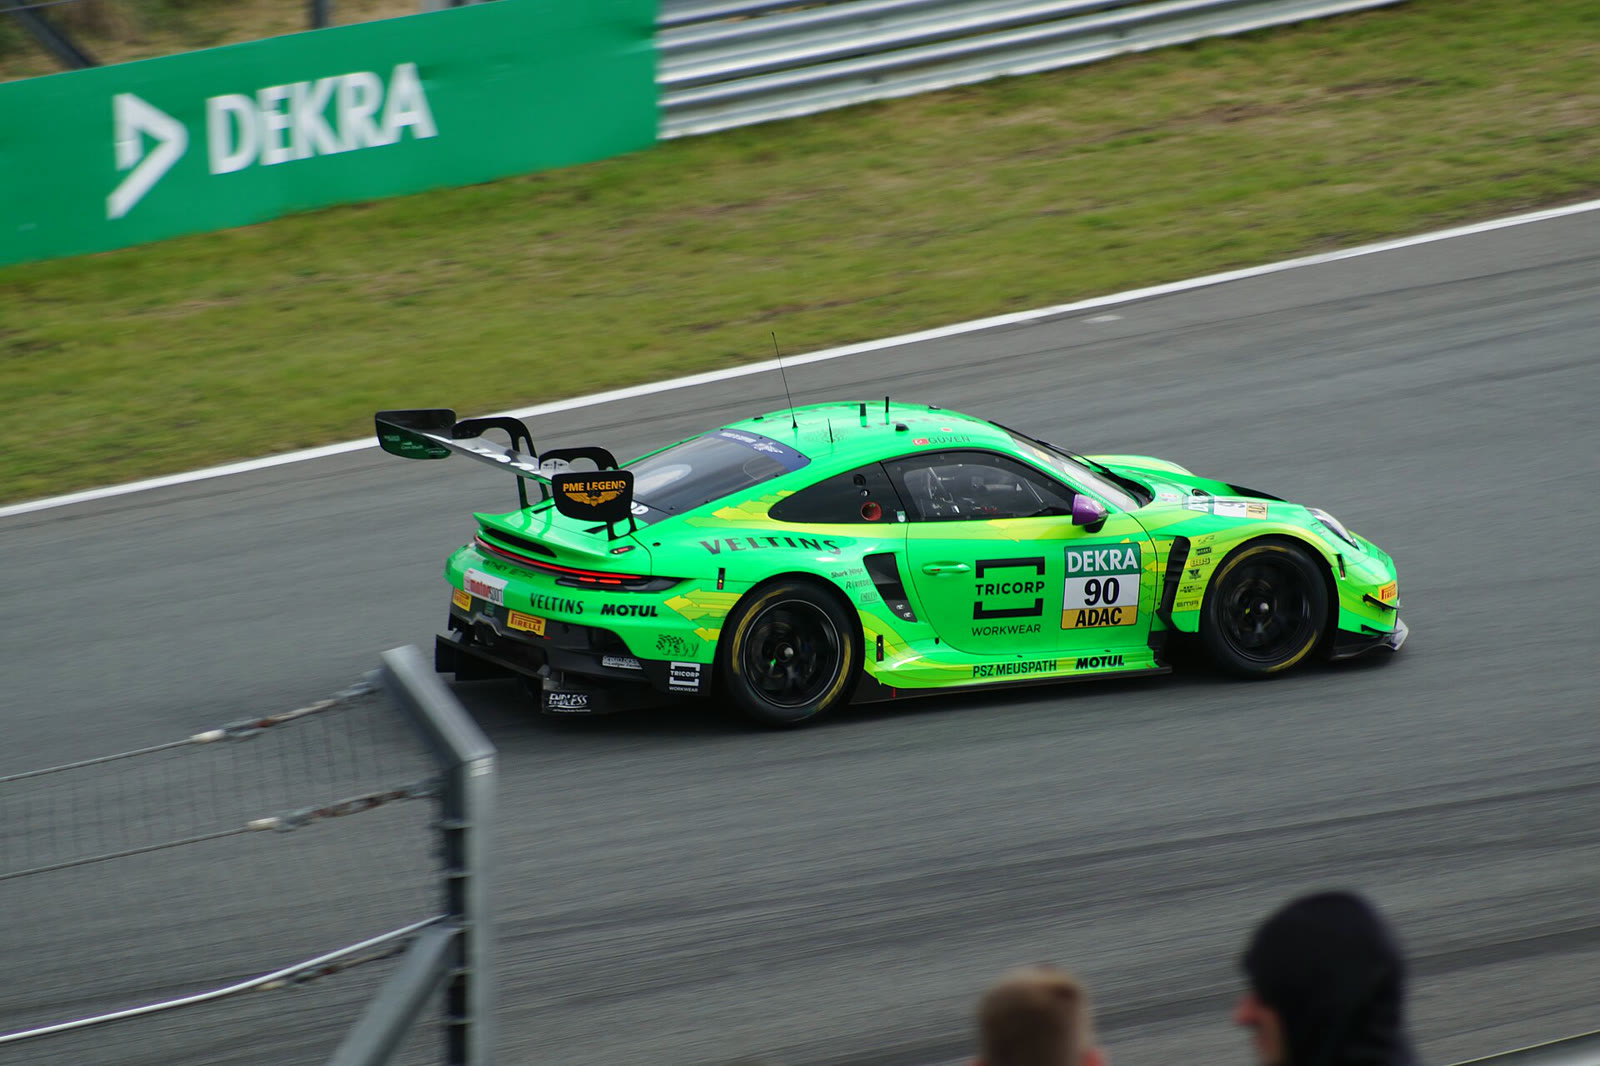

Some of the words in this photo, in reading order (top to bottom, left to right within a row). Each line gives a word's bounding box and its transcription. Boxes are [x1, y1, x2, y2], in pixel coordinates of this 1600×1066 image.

[206, 62, 438, 175] DEKRA
[562, 483, 585, 492] PME
[586, 480, 626, 491] LEGEND
[699, 536, 842, 556] VELTINS
[1067, 548, 1138, 573] DEKRA
[975, 581, 1045, 596] TRICORP
[1083, 577, 1120, 606] 90
[530, 593, 583, 615] VELTINS
[600, 603, 658, 618] MOTUL
[510, 612, 543, 632] PIRELLI
[1075, 607, 1122, 628] ADAC
[971, 624, 1041, 636] WORKWEAR
[972, 665, 994, 678] PSZ
[995, 660, 1057, 676] MEUSPATH
[1075, 655, 1125, 670] MOTUL
[670, 670, 700, 678] TRICORP
